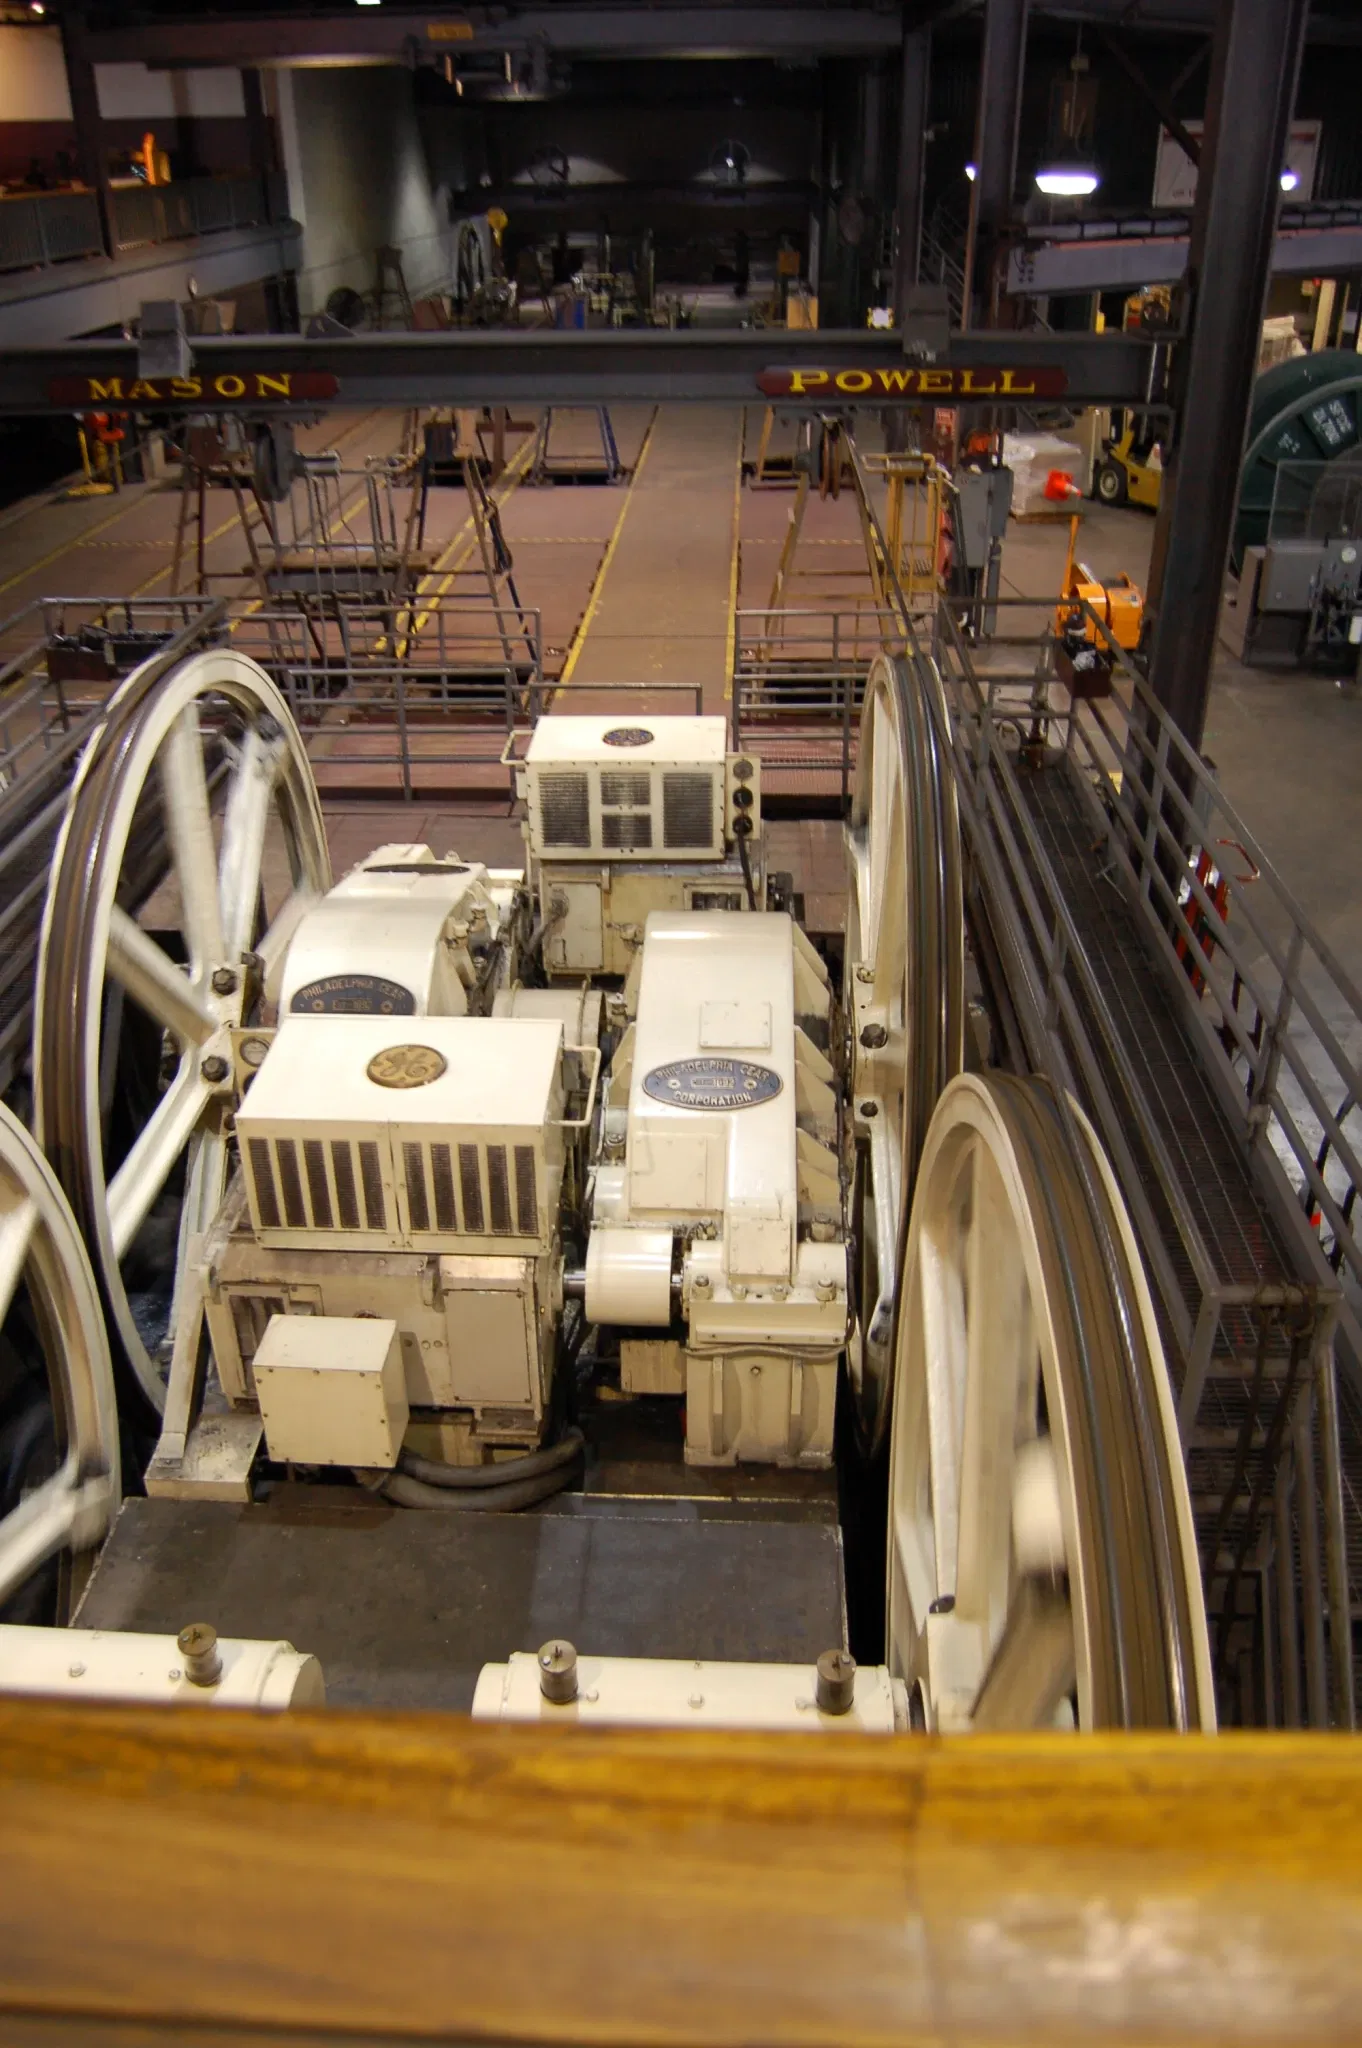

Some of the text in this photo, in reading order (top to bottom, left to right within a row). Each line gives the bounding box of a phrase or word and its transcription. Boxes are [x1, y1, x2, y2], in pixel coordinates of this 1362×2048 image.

[87, 373, 293, 400] MASON
[789, 369, 1036, 393] POWELL
[301, 978, 374, 1000] PHILADELPHIA
[655, 1059, 770, 1081] PHILADELPHIA GEAR
[673, 1090, 752, 1106] CORPORATION
